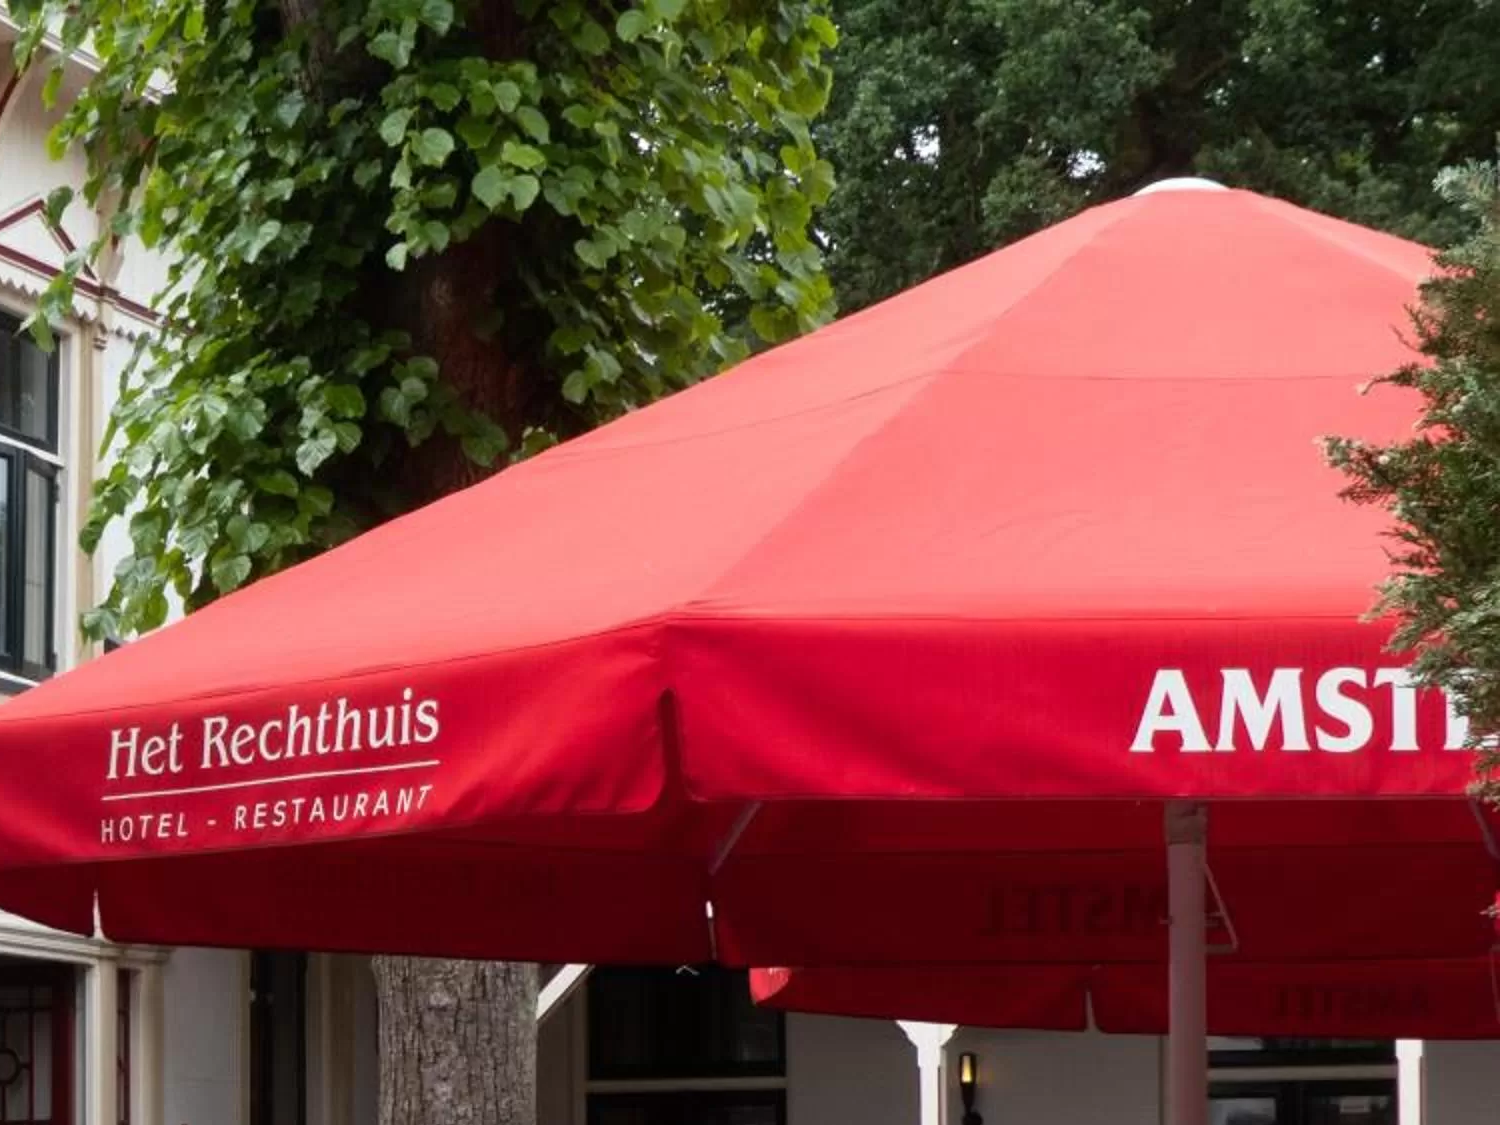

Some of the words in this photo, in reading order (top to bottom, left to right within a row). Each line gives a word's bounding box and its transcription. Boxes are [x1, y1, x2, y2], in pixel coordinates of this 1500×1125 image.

[106, 722, 183, 780] Het
[200, 687, 440, 769] Rechthuis
[100, 812, 189, 844] HOTEL
[234, 785, 433, 831] RESTAURANT
